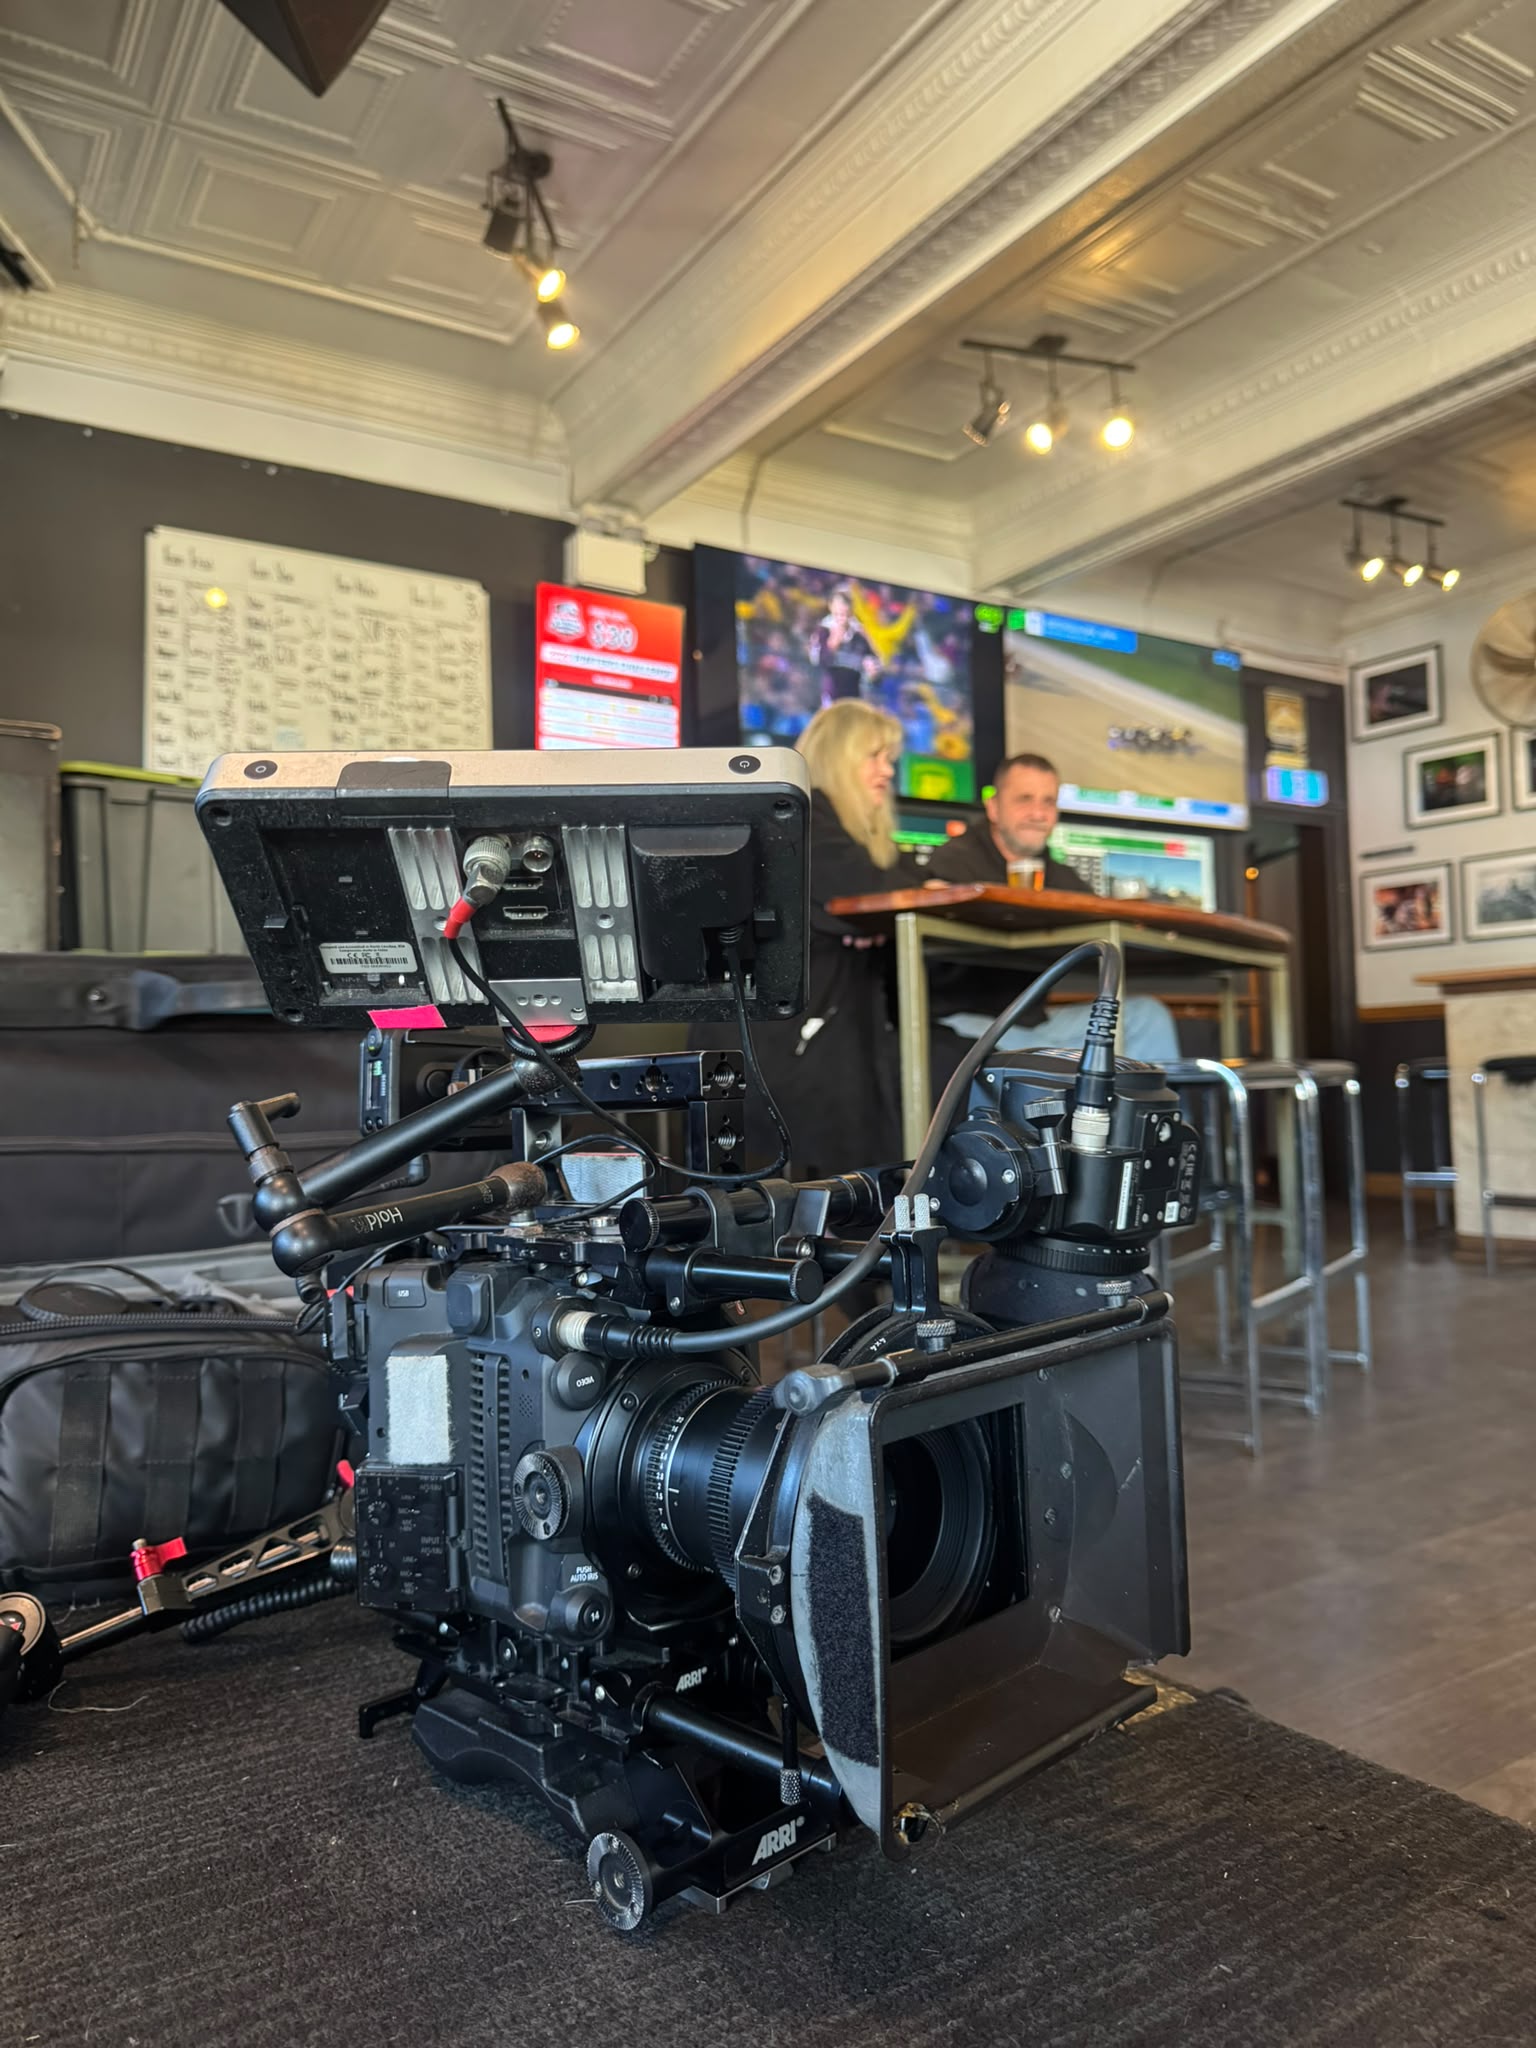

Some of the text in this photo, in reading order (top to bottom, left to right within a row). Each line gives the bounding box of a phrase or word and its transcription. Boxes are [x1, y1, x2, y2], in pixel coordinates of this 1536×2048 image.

[365, 1207, 403, 1231] Hold
[570, 1571, 599, 1583] AUTO IRIS
[576, 1565, 592, 1574] PUSH
[590, 1610, 600, 1622] 14
[675, 1669, 702, 1693] ARRI
[751, 1820, 796, 1866] ARRI
